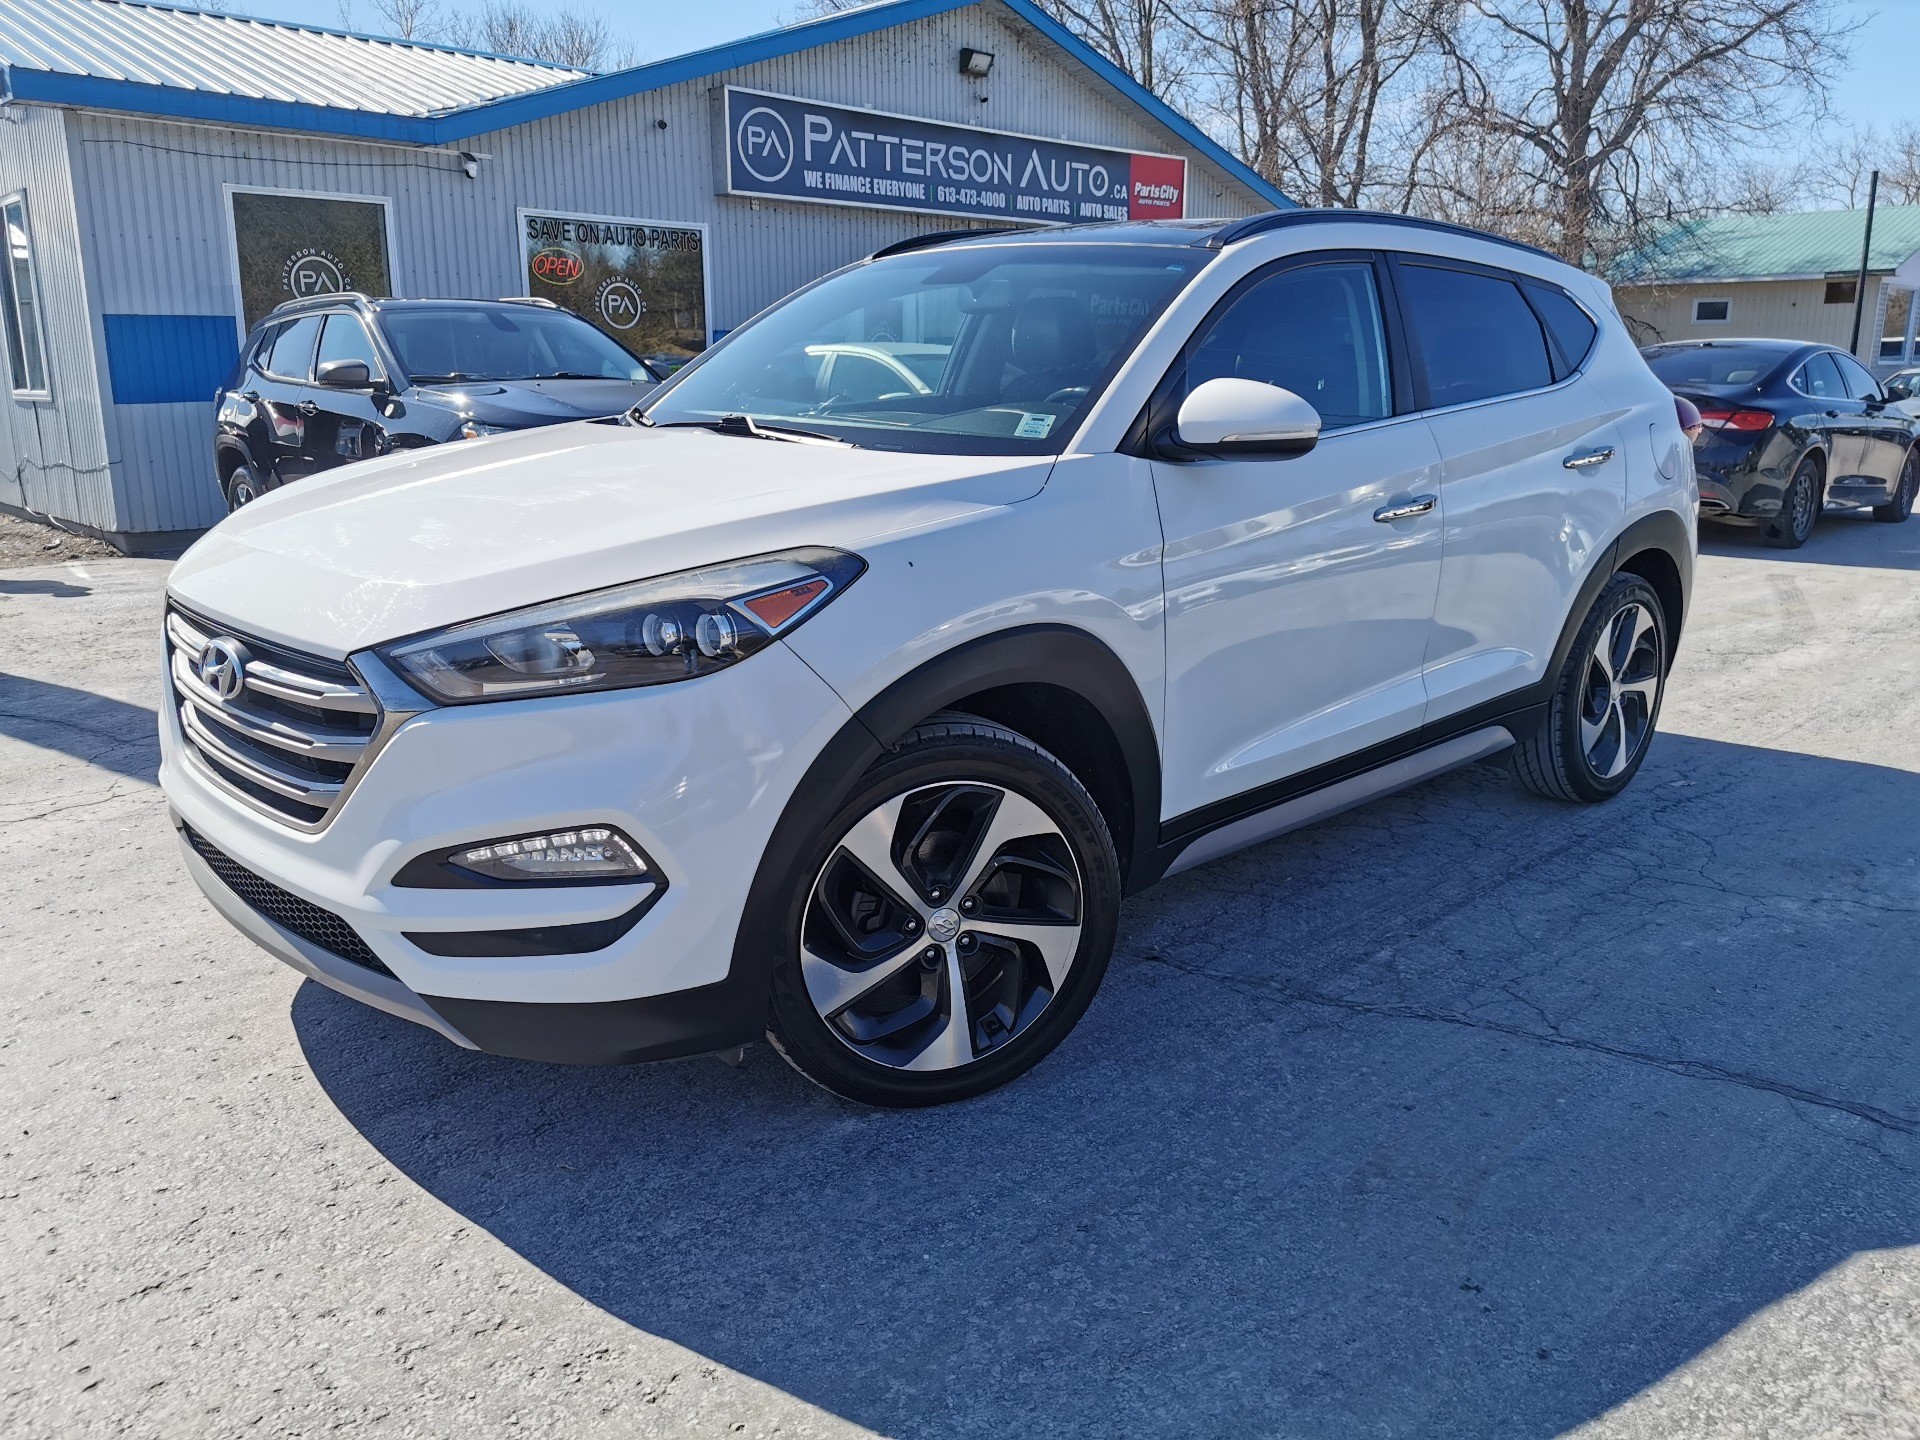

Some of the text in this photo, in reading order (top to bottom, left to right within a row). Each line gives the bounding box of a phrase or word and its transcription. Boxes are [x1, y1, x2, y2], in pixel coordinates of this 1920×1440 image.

[747, 125, 786, 160] PA
[804, 114, 1128, 200] PATTERSON AUTO .CA
[804, 169, 1128, 222] WE FINANCE EVERYONE 613-473-4000 AUTO PARTS AUTO SALES
[1133, 181, 1179, 204] PartsCity
[527, 218, 700, 251] SAVE ON AUTO PARTS
[282, 247, 316, 291] PATTERSON
[320, 250, 344, 270] AUTO
[299, 270, 337, 293] PA
[534, 255, 579, 277] OPEN
[594, 275, 622, 313] PATTERSON
[624, 277, 642, 295] AUTO
[607, 294, 636, 314] PA
